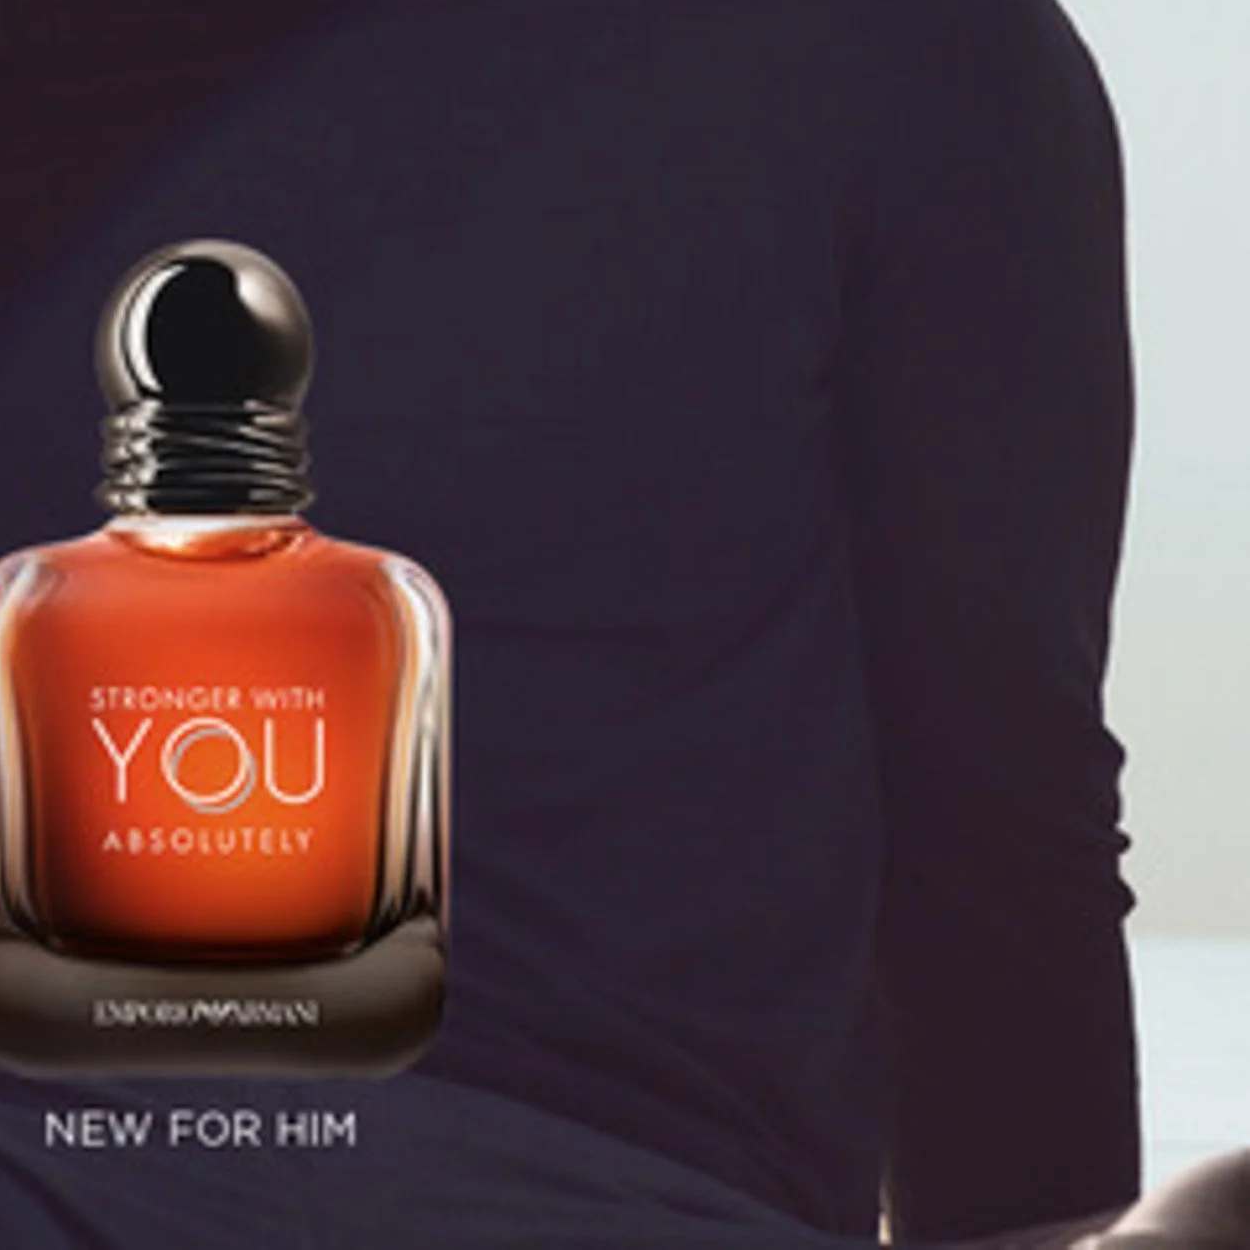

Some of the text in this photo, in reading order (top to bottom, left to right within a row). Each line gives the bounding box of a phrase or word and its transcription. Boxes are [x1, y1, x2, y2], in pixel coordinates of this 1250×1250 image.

[91, 686, 326, 713] STRONGER WITH
[91, 716, 327, 812] YOU
[102, 826, 315, 856] ABSOLUTELY
[45, 1110, 357, 1148] NEW FOR HIM
